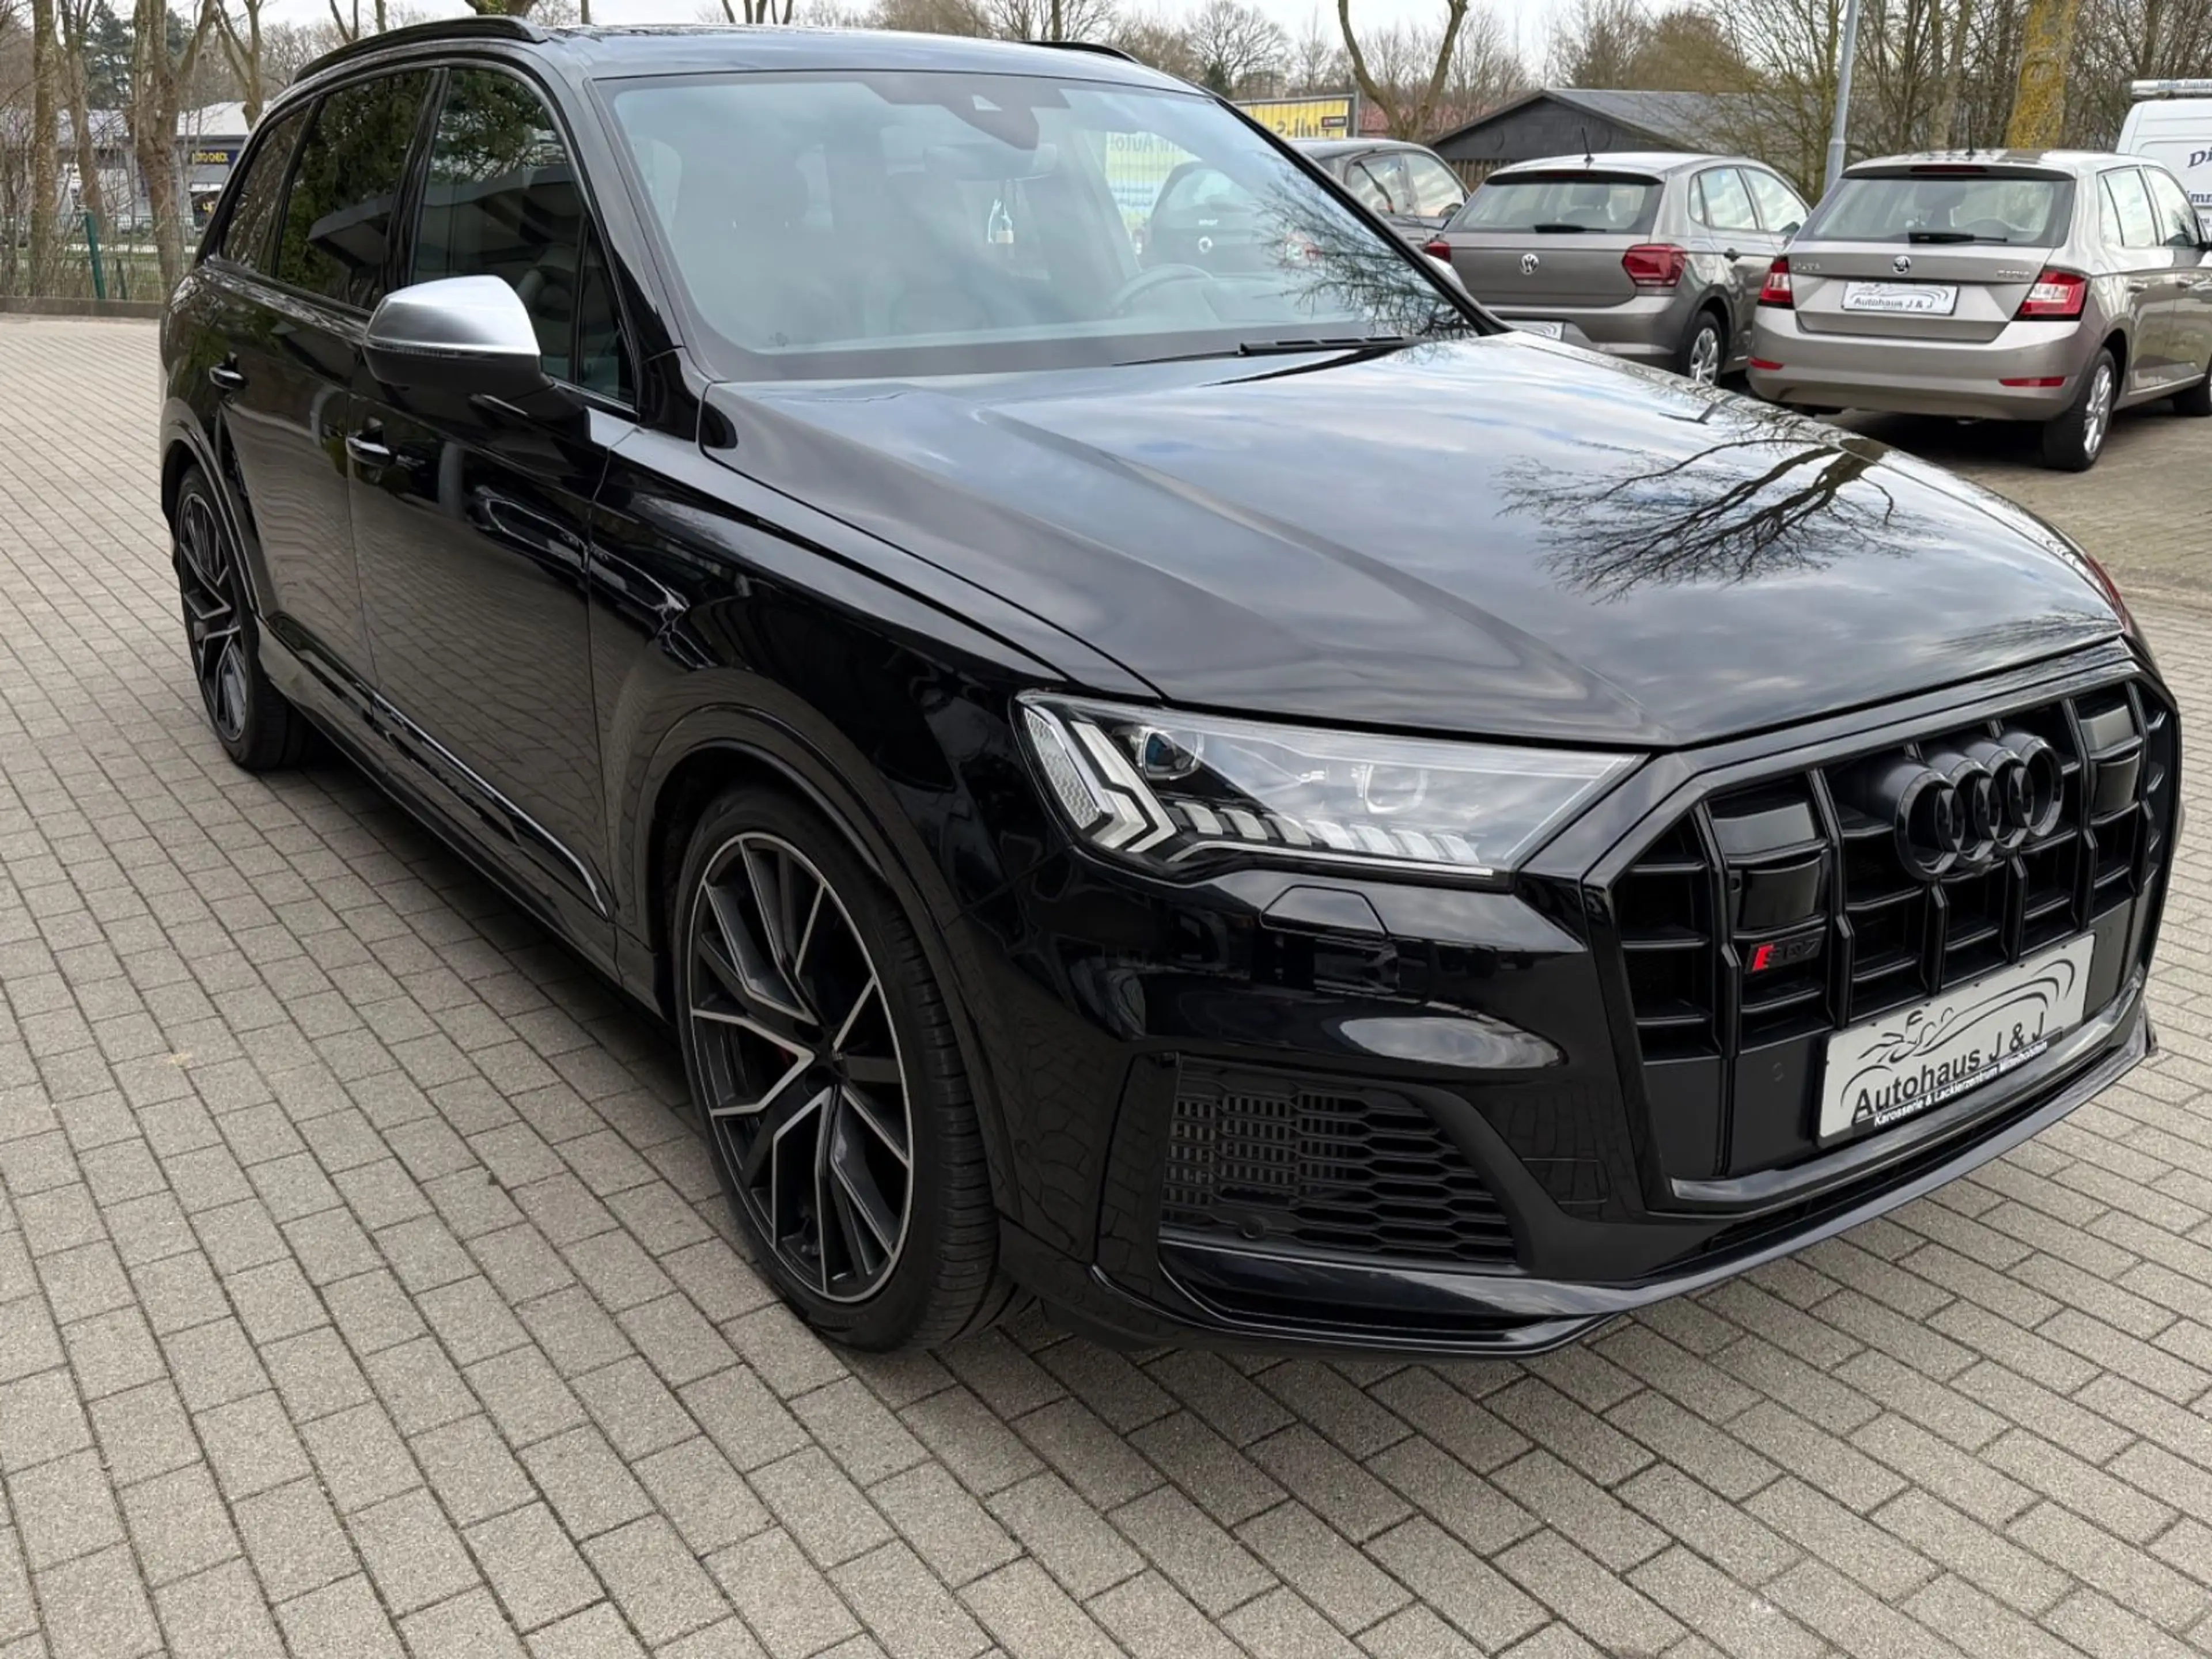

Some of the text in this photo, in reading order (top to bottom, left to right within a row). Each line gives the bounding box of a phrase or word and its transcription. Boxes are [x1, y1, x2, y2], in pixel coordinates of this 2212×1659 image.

[1854, 297, 1903, 309] Autohaus
[1906, 300, 1913, 309] J
[1915, 300, 1923, 308] &
[1851, 1049, 1981, 1125] Autohaus
[1988, 1031, 2003, 1063] J
[2009, 1021, 2024, 1052] &
[2032, 1011, 2045, 1042] J
[1874, 1097, 1924, 1127] Karosserie
[1925, 1093, 1934, 1107] &
